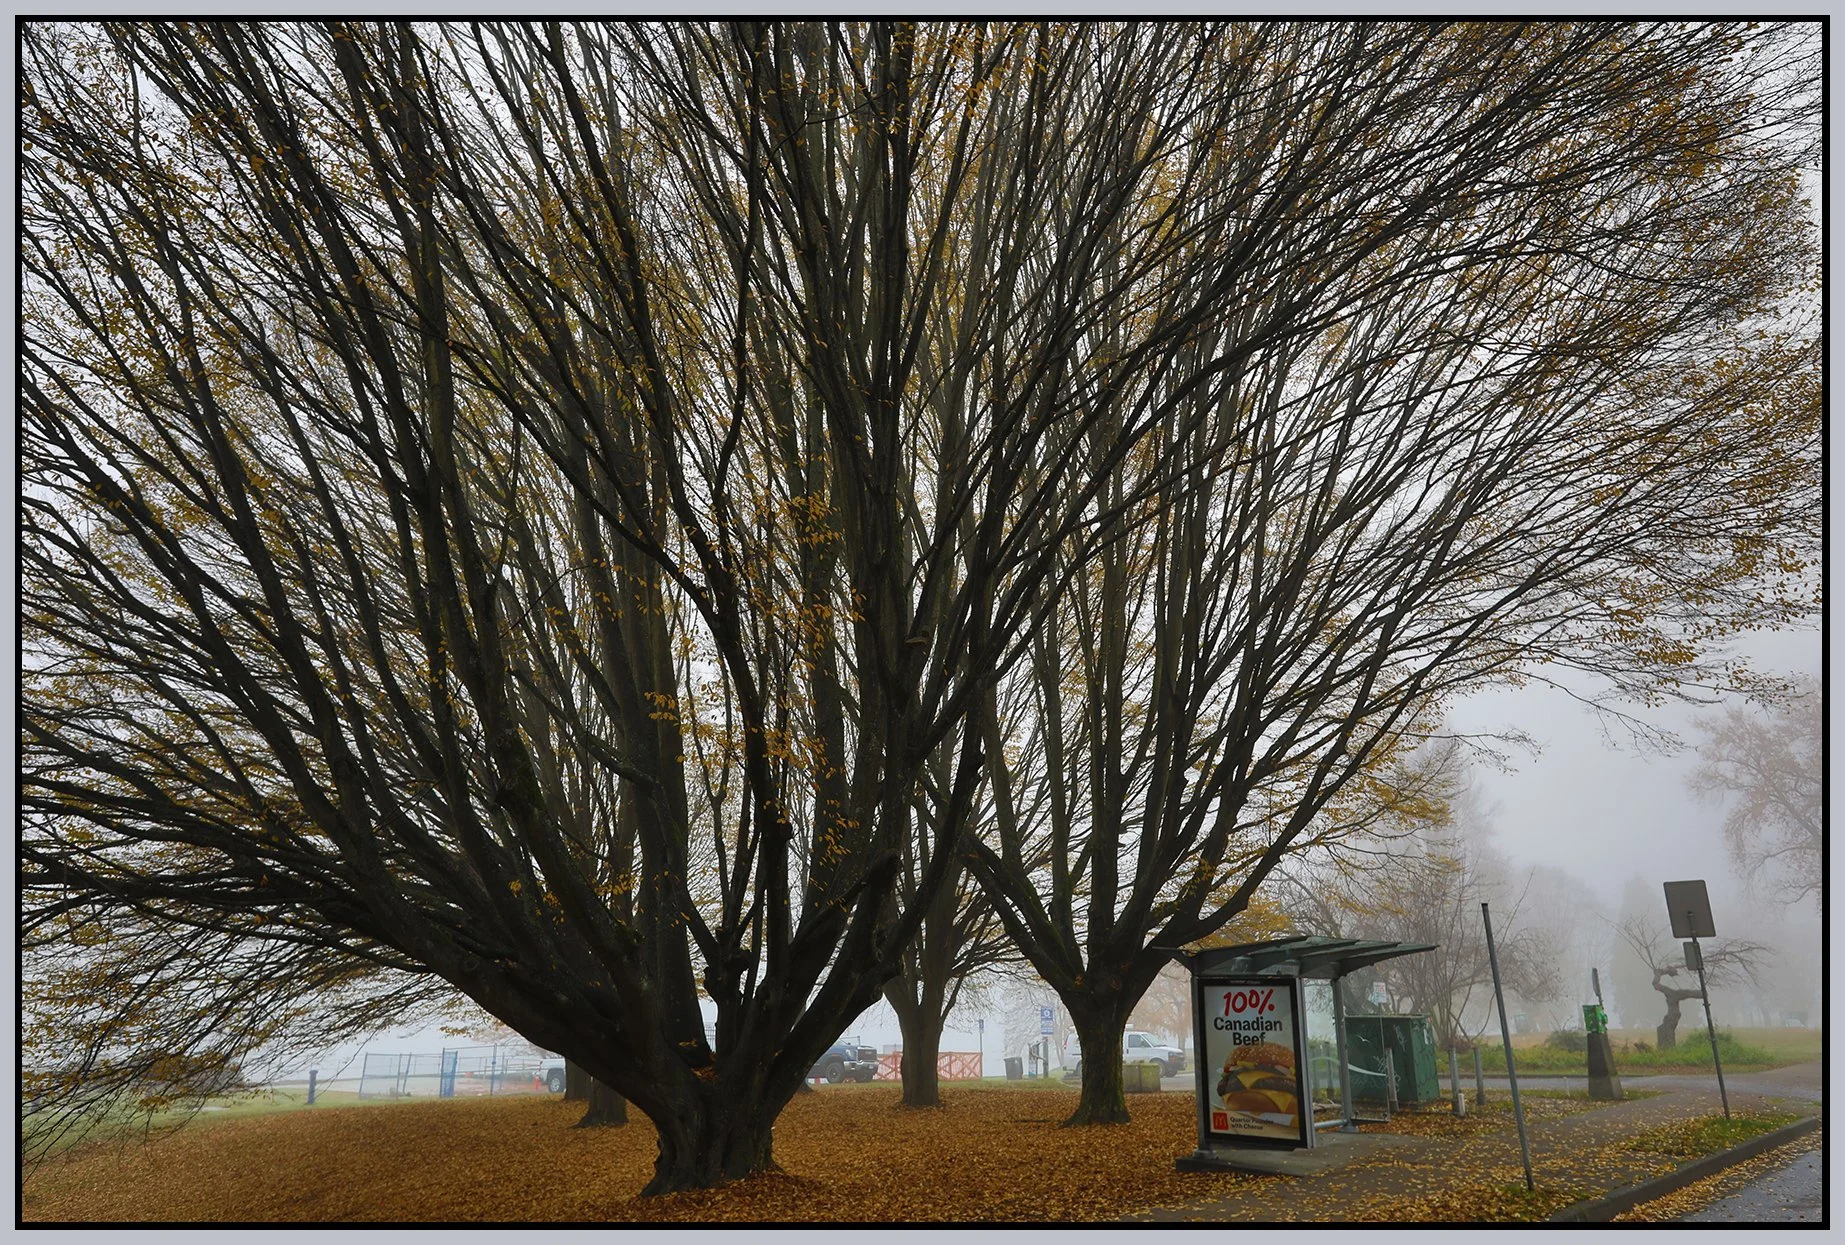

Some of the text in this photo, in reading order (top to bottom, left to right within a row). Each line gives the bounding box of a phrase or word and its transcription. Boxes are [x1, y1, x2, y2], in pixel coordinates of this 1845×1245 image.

[1223, 988, 1275, 1016] 100%
[1214, 1016, 1282, 1031] Canadian
[1232, 1032, 1266, 1047] Beef
